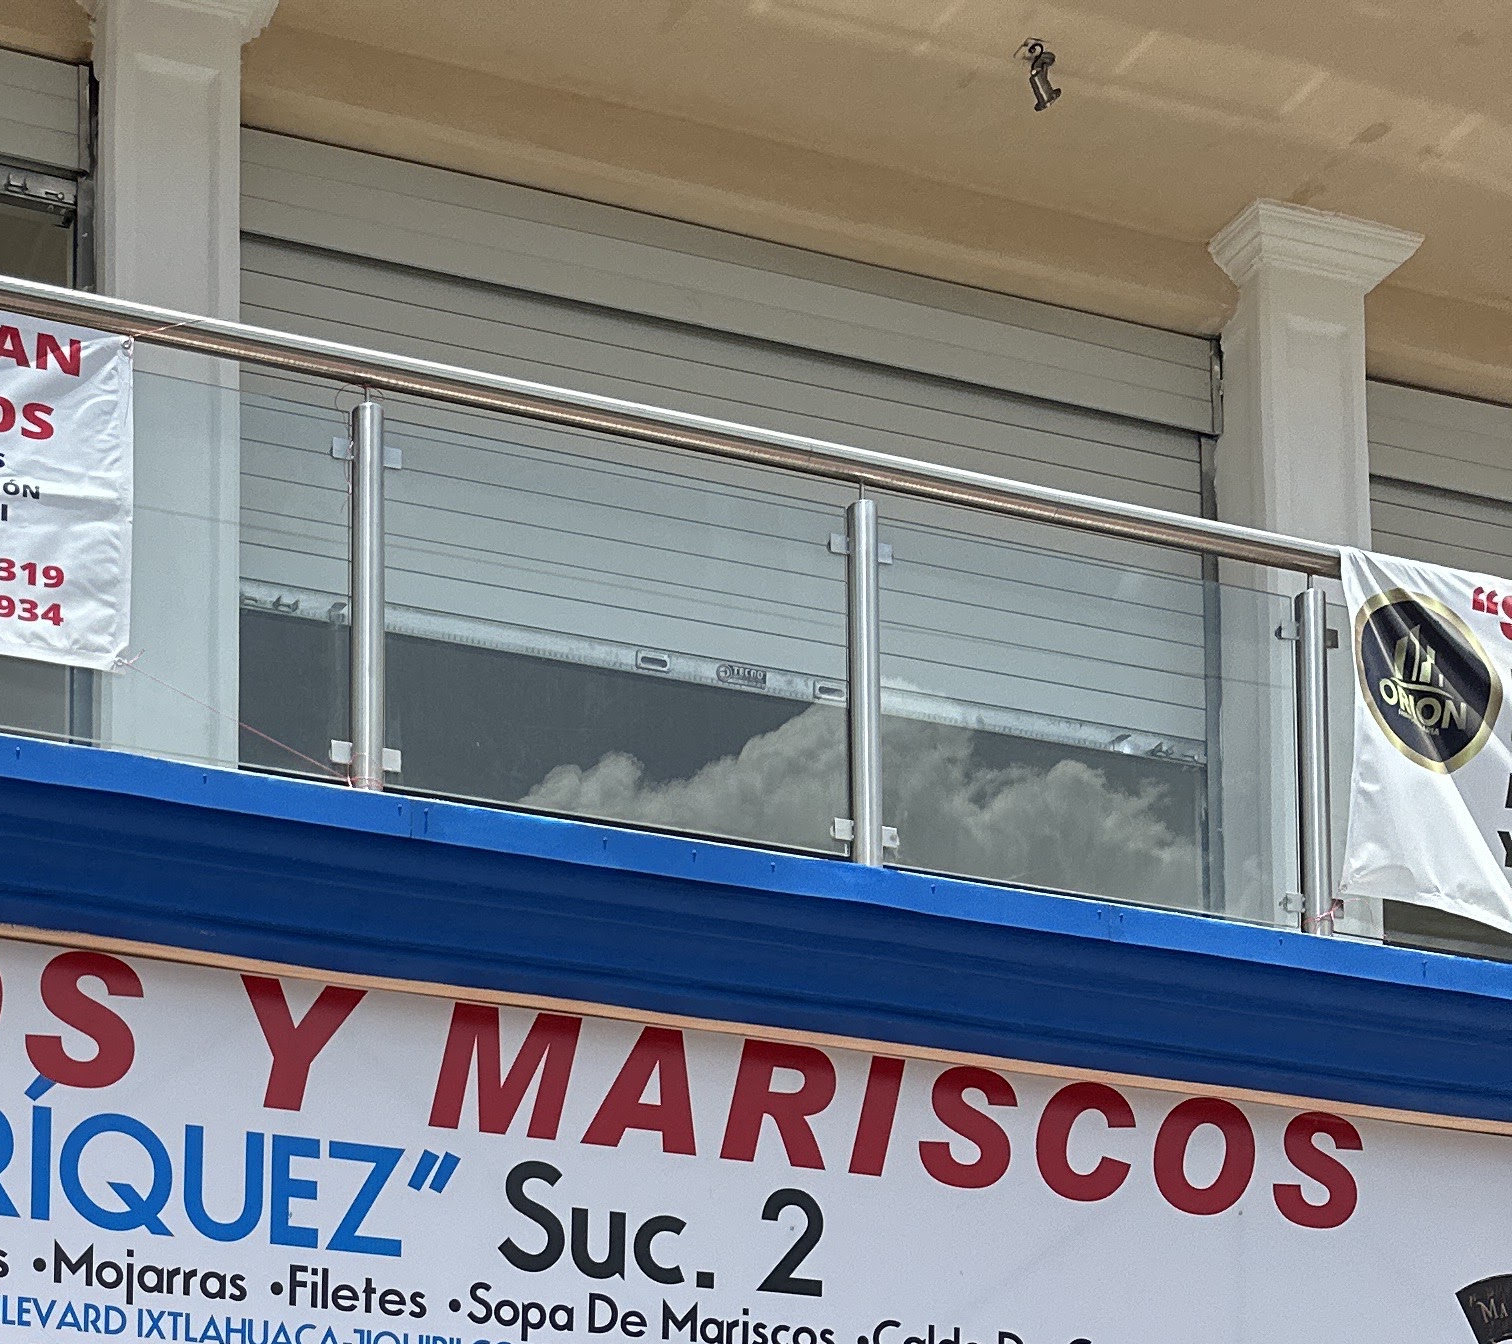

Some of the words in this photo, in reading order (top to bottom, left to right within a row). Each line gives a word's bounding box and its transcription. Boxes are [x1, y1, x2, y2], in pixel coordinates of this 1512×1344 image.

[1379, 678, 1468, 730] ORION
[240, 975, 367, 1111] Y
[429, 1002, 1363, 1228] MARISCOS
[497, 1161, 715, 1284] Suc.
[757, 1188, 823, 1296] 2
[588, 1296, 647, 1338] De
